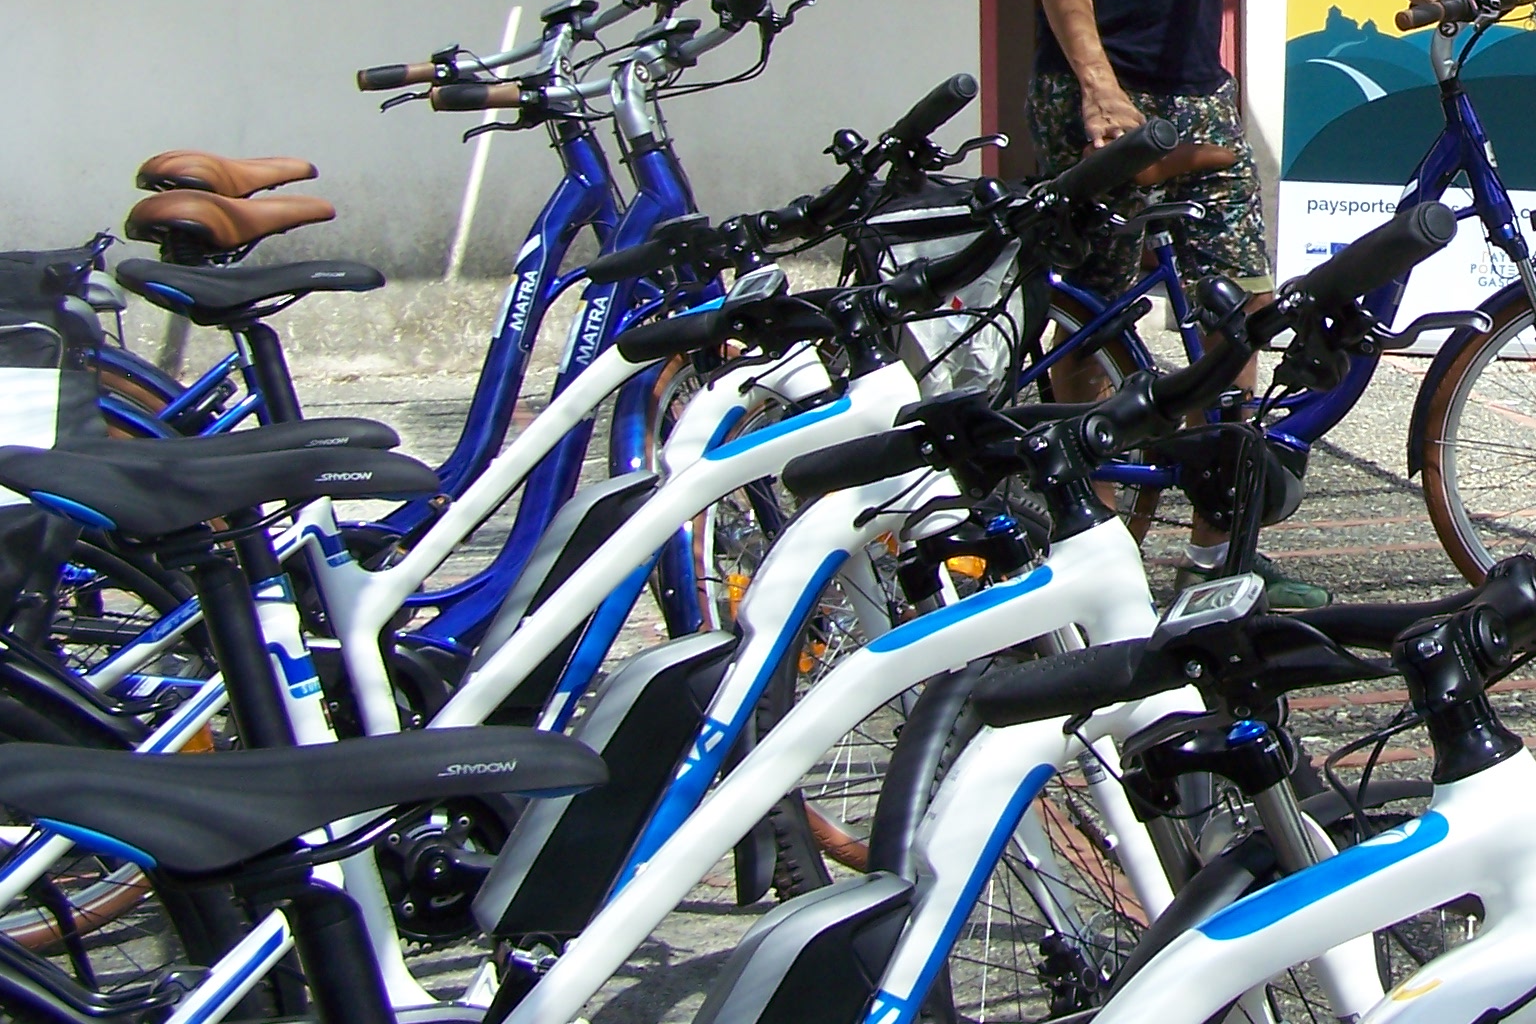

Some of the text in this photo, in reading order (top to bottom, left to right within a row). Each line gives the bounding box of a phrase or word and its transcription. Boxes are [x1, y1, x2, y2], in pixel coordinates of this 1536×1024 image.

[1307, 199, 1397, 216] paysporte
[509, 270, 539, 332] MATRA
[576, 296, 610, 366] MATRA
